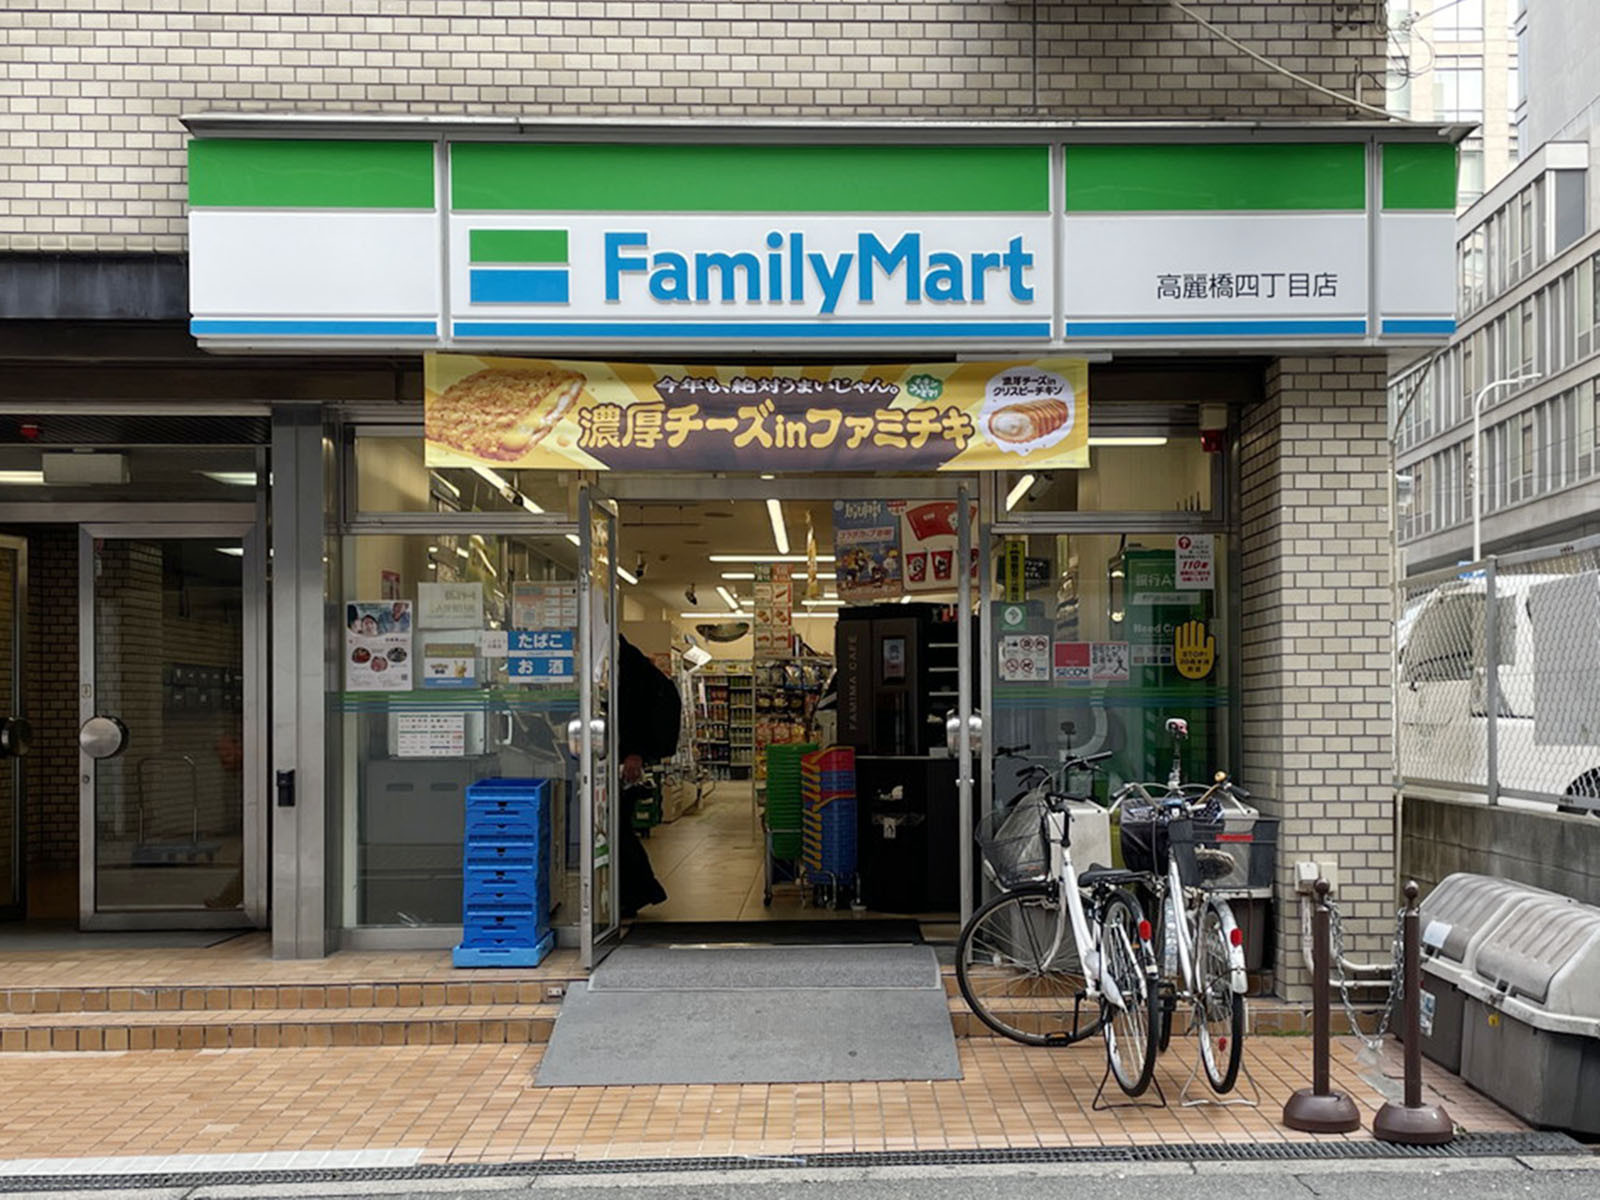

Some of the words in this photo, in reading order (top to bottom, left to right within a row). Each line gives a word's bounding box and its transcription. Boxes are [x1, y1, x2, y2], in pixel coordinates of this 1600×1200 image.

[603, 231, 1035, 315] FamilyMart
[1156, 272, 1338, 299] 高麗橋四丁目店
[655, 376, 899, 394] 今年も、絶対うまいじゃん。
[993, 384, 1064, 396] クリスピーチキン
[579, 399, 972, 449] 濃厚チーズinファミチキ
[518, 633, 563, 649] たばこ
[1056, 668, 1089, 677] SECOM
